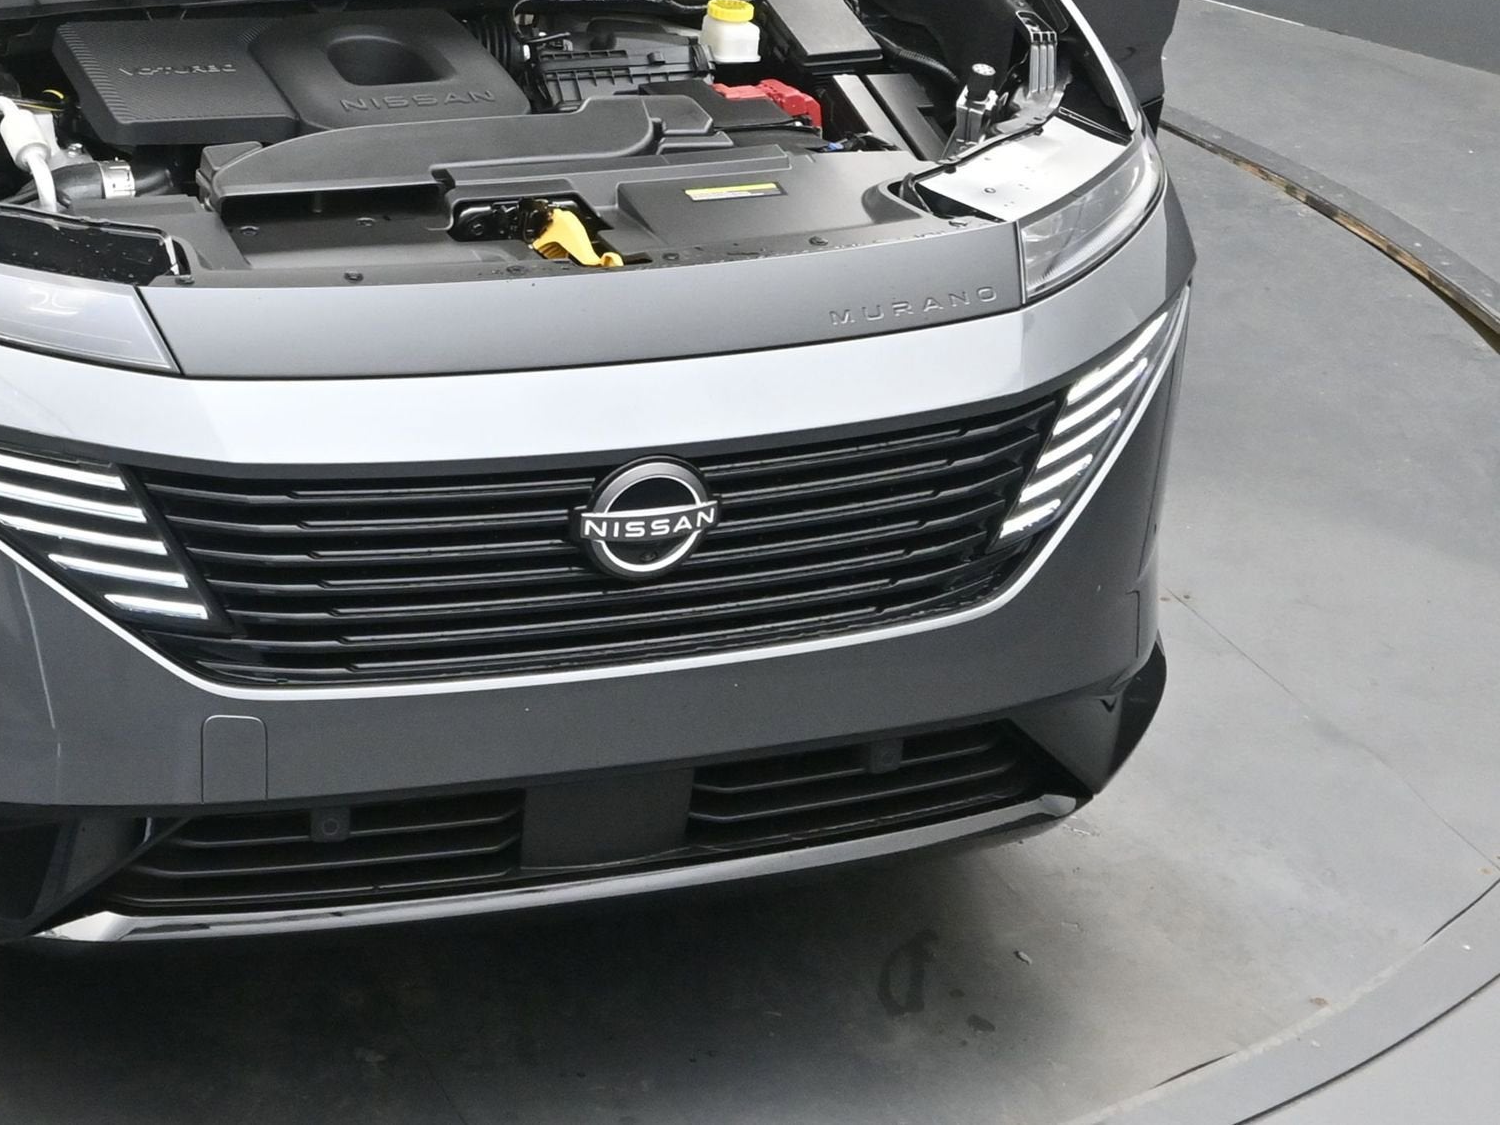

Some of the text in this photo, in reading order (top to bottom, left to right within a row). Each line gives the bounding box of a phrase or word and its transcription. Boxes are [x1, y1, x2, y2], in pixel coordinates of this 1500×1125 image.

[339, 89, 496, 112] NISSAN
[829, 286, 998, 326] MURANO
[583, 507, 715, 538] NISSAN
